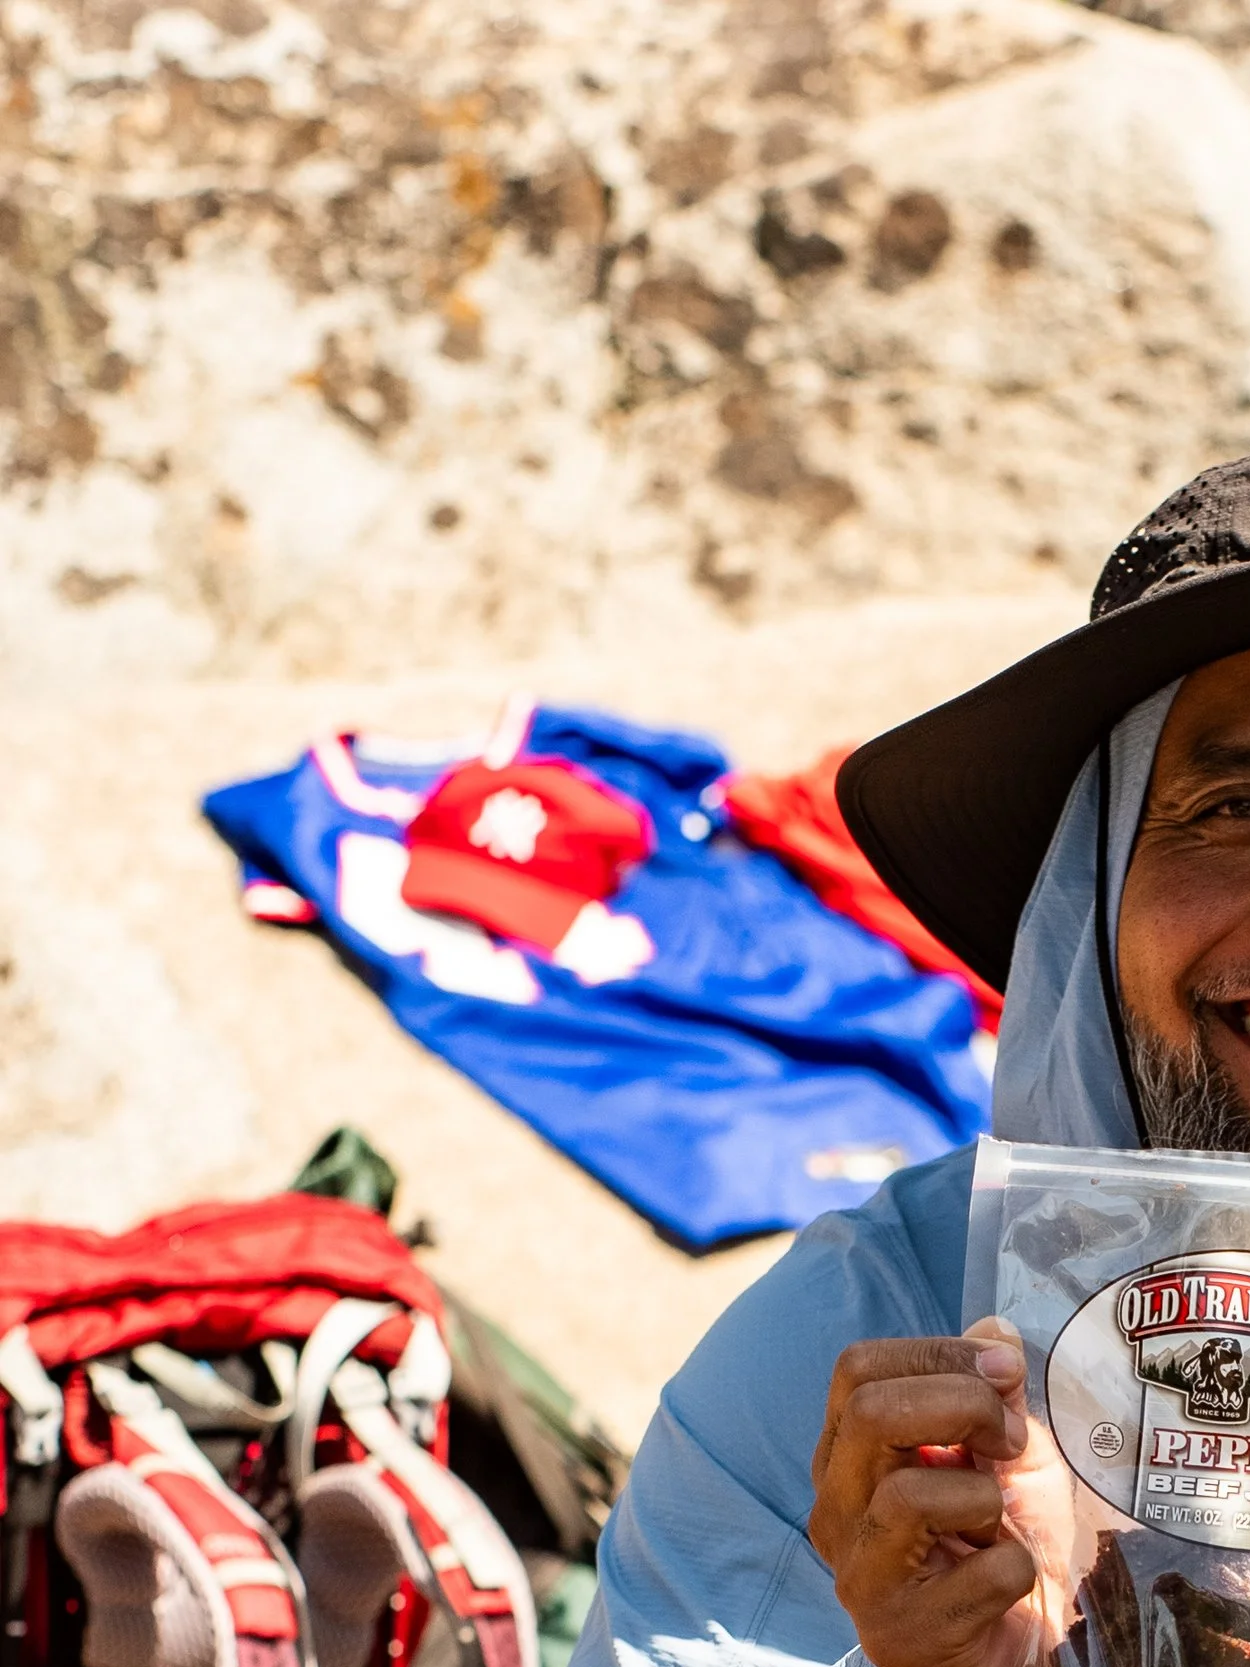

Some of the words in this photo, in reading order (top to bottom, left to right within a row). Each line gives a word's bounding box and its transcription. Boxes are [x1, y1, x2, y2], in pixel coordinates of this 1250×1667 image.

[1120, 1286, 1179, 1332] OLD
[1193, 1408, 1220, 1417] SINCE
[1222, 1410, 1241, 1419] 1969
[1147, 1474, 1241, 1498] BEEF
[1145, 1503, 1170, 1520] NET
[1172, 1506, 1191, 1523] WT.
[1194, 1509, 1202, 1524] 8
